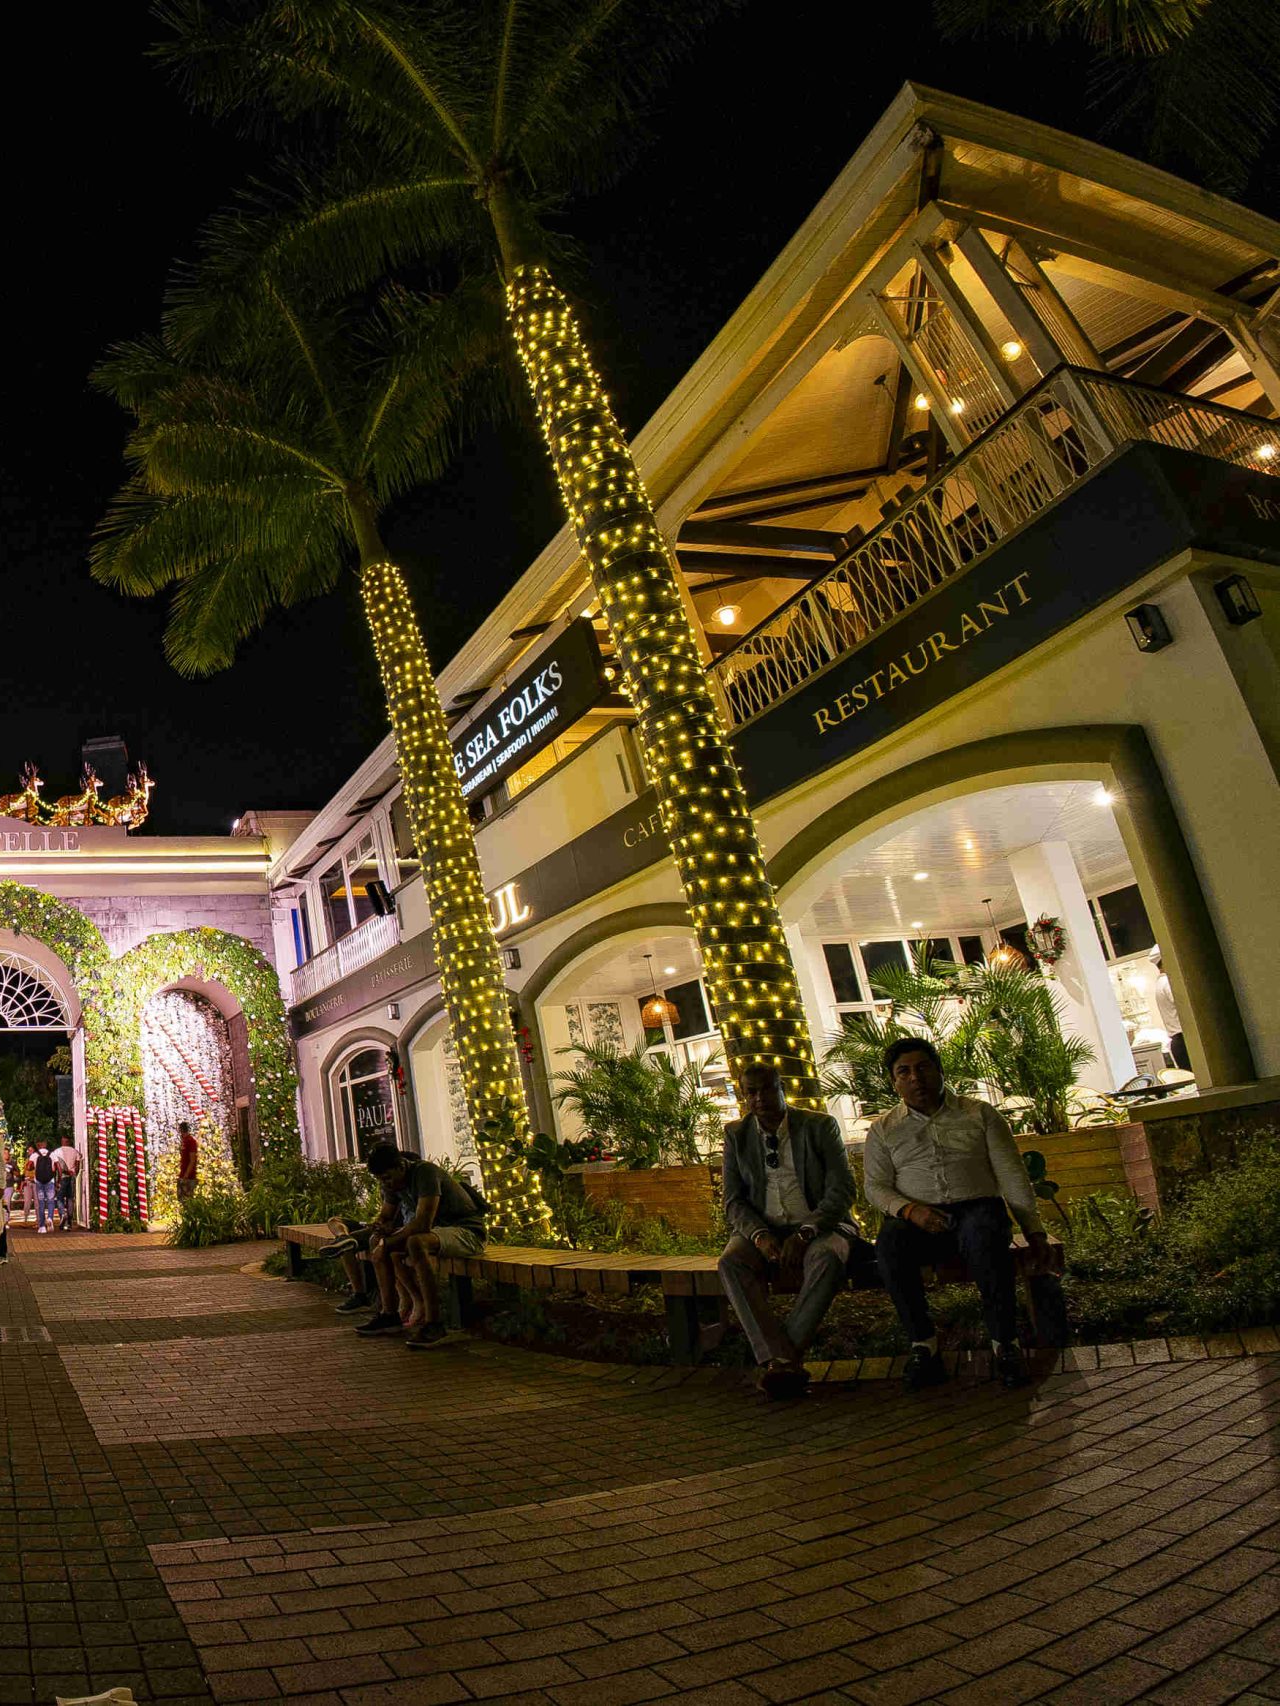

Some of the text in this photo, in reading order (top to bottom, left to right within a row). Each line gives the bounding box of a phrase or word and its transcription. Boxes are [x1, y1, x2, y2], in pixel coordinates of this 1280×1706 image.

[812, 572, 1032, 735] RESTAURANT
[466, 724, 500, 768] SEA
[497, 660, 563, 738] FOLKS
[496, 734, 527, 767] SEAFOOD
[530, 705, 559, 736] INDIAN
[358, 1103, 392, 1128] PAUL
